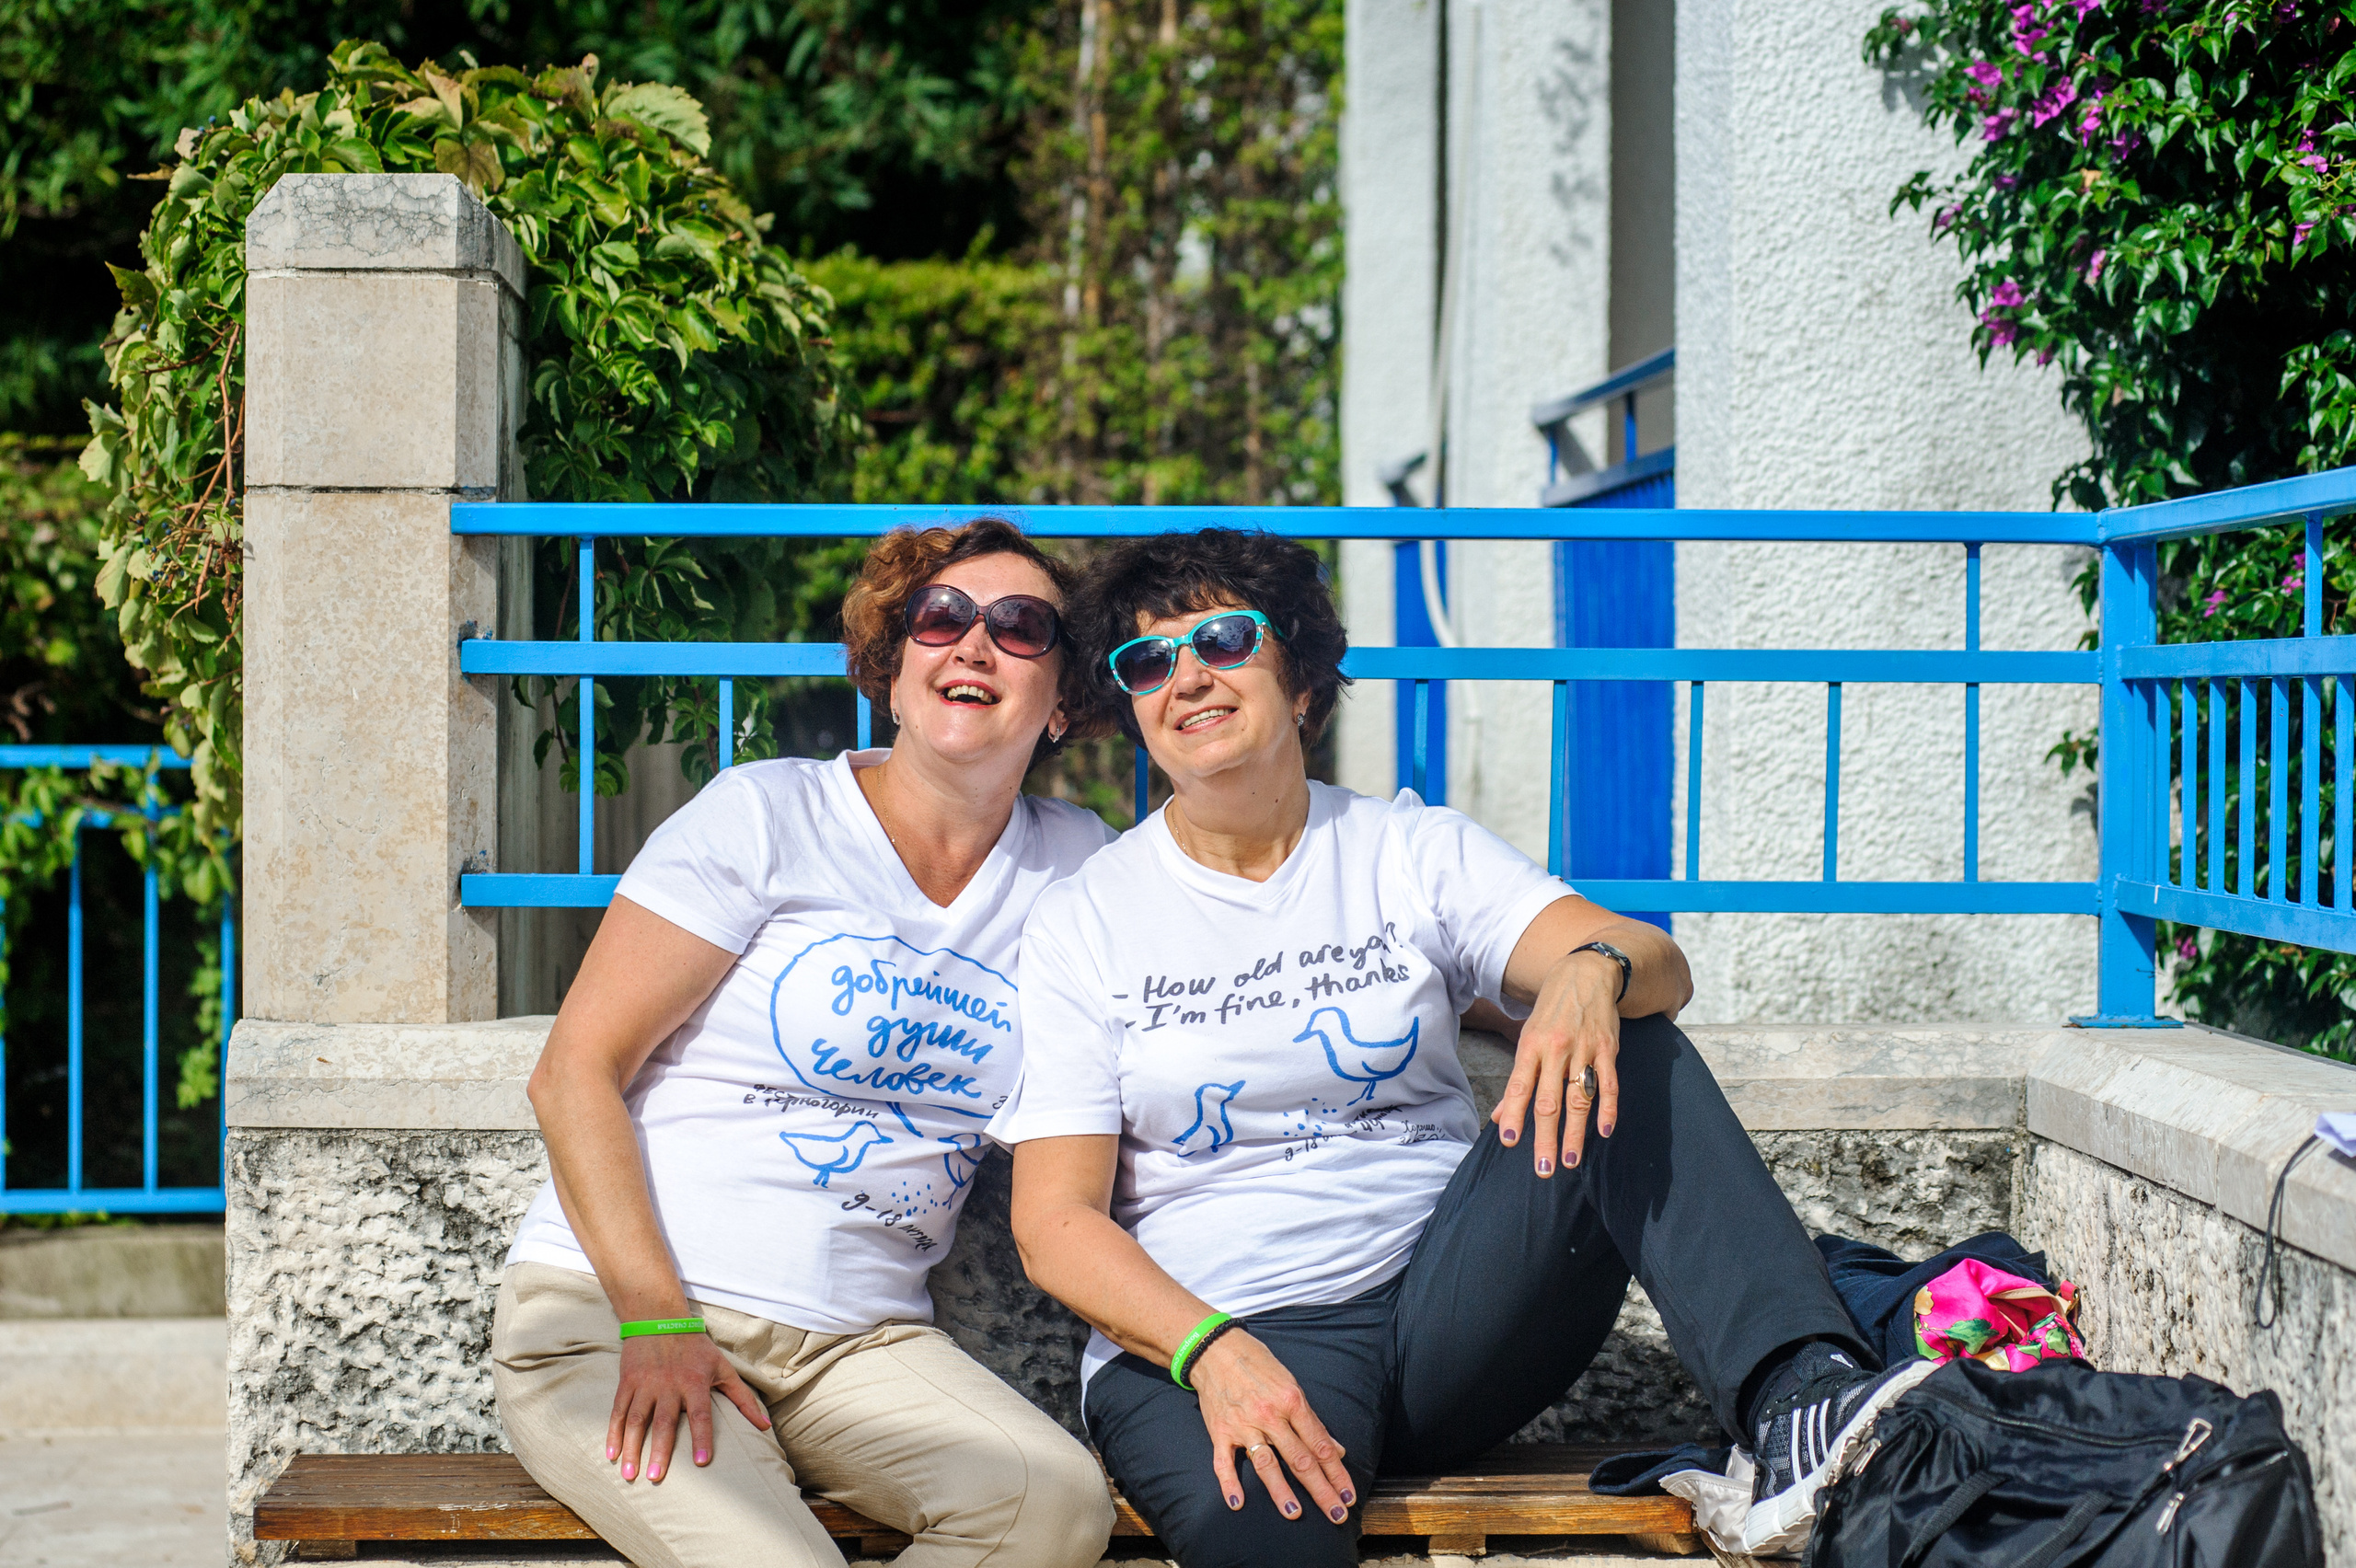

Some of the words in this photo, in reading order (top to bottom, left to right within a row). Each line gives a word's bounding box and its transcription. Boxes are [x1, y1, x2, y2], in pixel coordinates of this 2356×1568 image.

[1141, 1002, 1207, 1032] I'm
[1214, 990, 1300, 1025] fine,
[1304, 957, 1410, 1001] thanks
[1143, 975, 1216, 1004] How
[1234, 951, 1283, 987] old
[1299, 943, 1345, 967] are
[866, 1015, 994, 1065] души
[841, 1193, 903, 1227] 9-18
